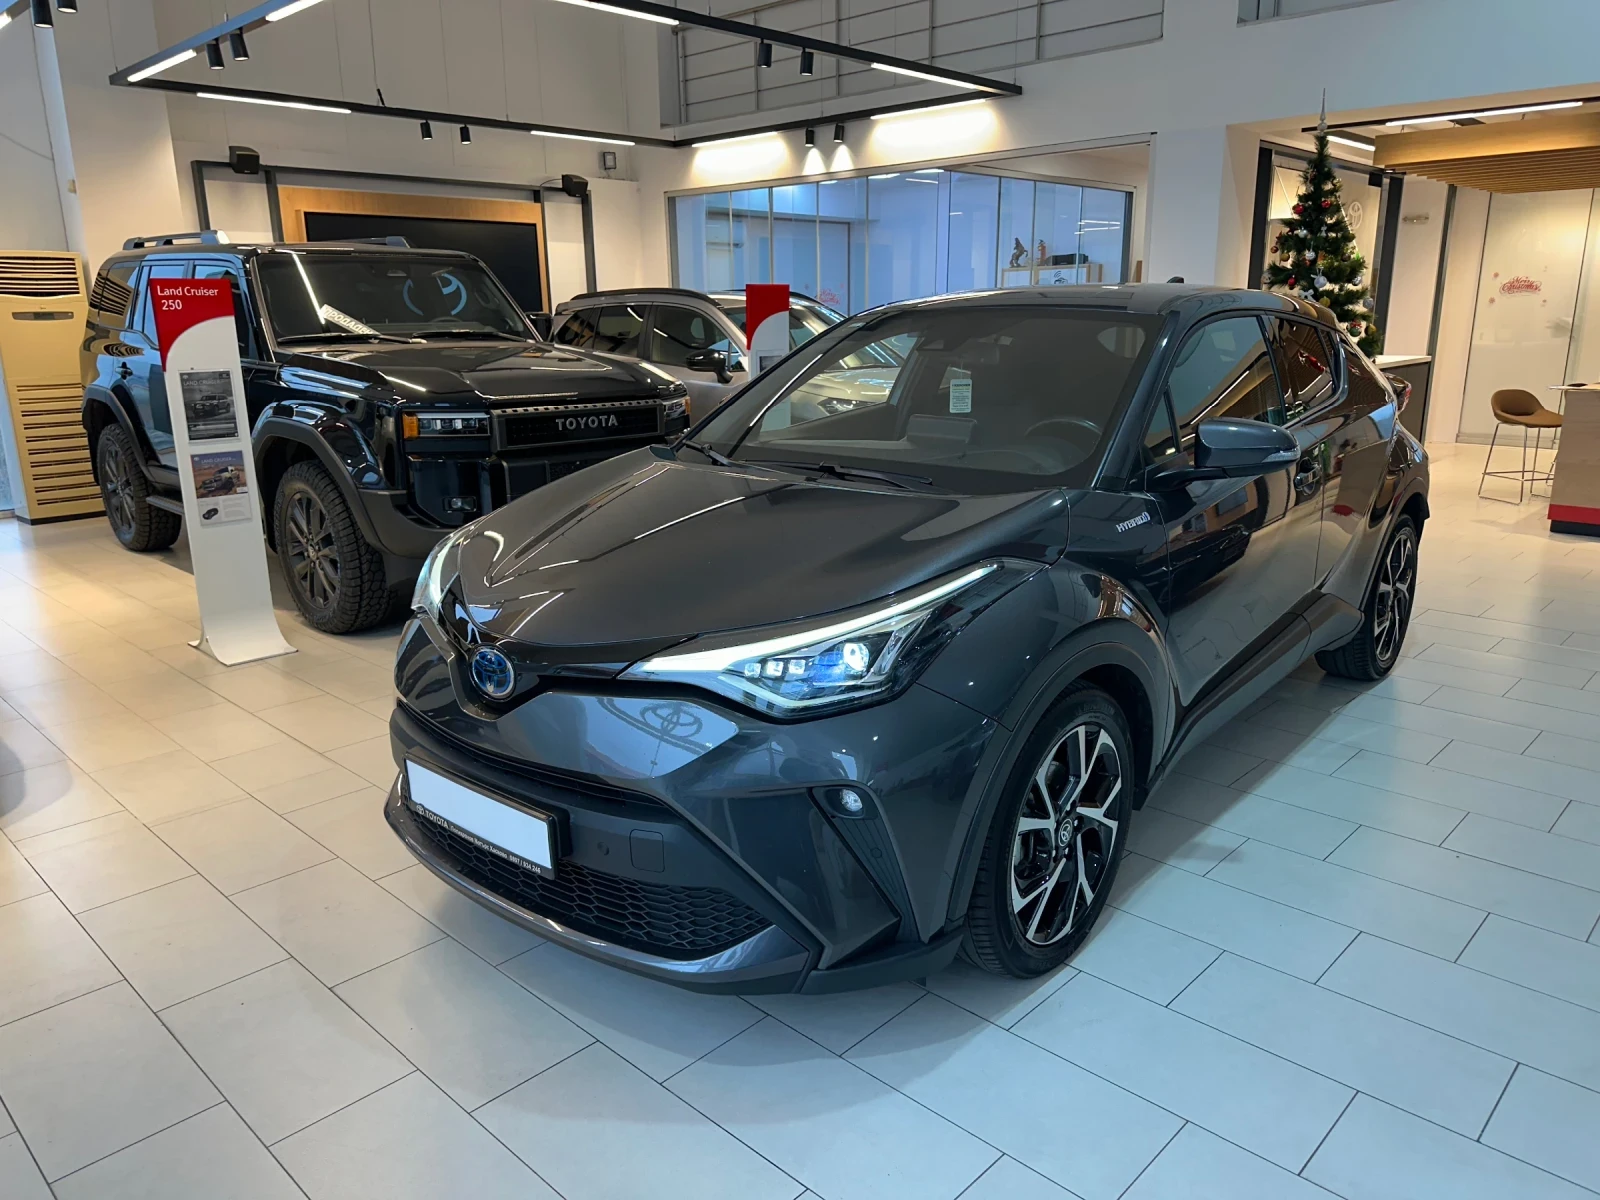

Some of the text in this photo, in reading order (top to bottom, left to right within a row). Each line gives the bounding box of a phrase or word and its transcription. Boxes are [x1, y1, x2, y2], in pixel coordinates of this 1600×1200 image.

[157, 285, 219, 296] Land Cruiser
[161, 299, 183, 310] 250
[555, 414, 619, 431] TOYOTA
[1115, 511, 1151, 533] HYBRID
[425, 810, 449, 829] TOYOTA
